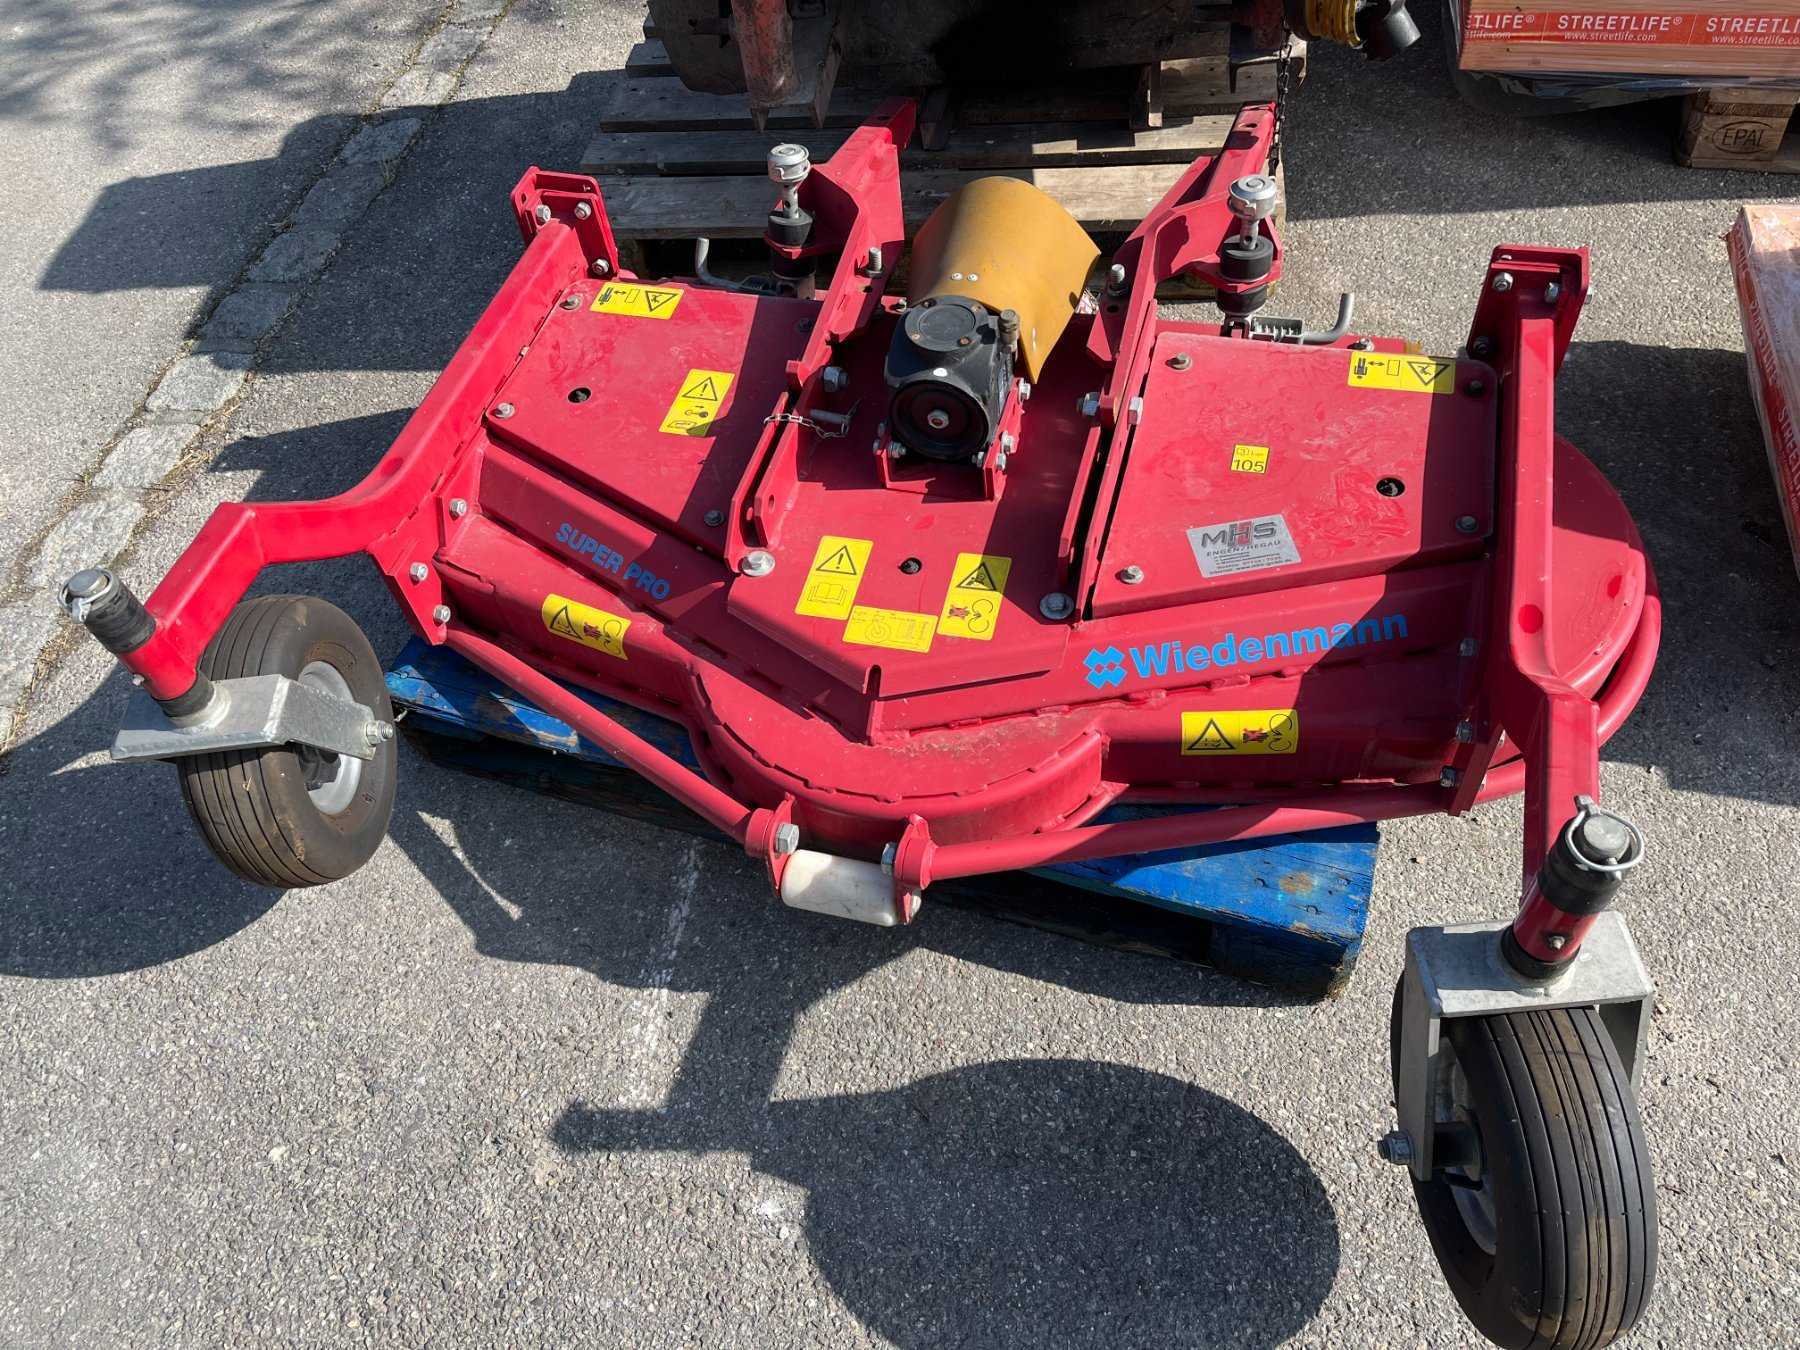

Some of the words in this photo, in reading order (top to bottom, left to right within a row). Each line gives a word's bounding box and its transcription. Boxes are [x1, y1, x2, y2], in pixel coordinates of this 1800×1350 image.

[1564, 32, 1657, 41] www.streetlife.com
[1233, 459, 1265, 472] 105
[1201, 521, 1277, 548] MHS
[556, 522, 624, 574] SUPER
[623, 562, 670, 600] PRO
[1129, 612, 1409, 679] Wiedenmann
